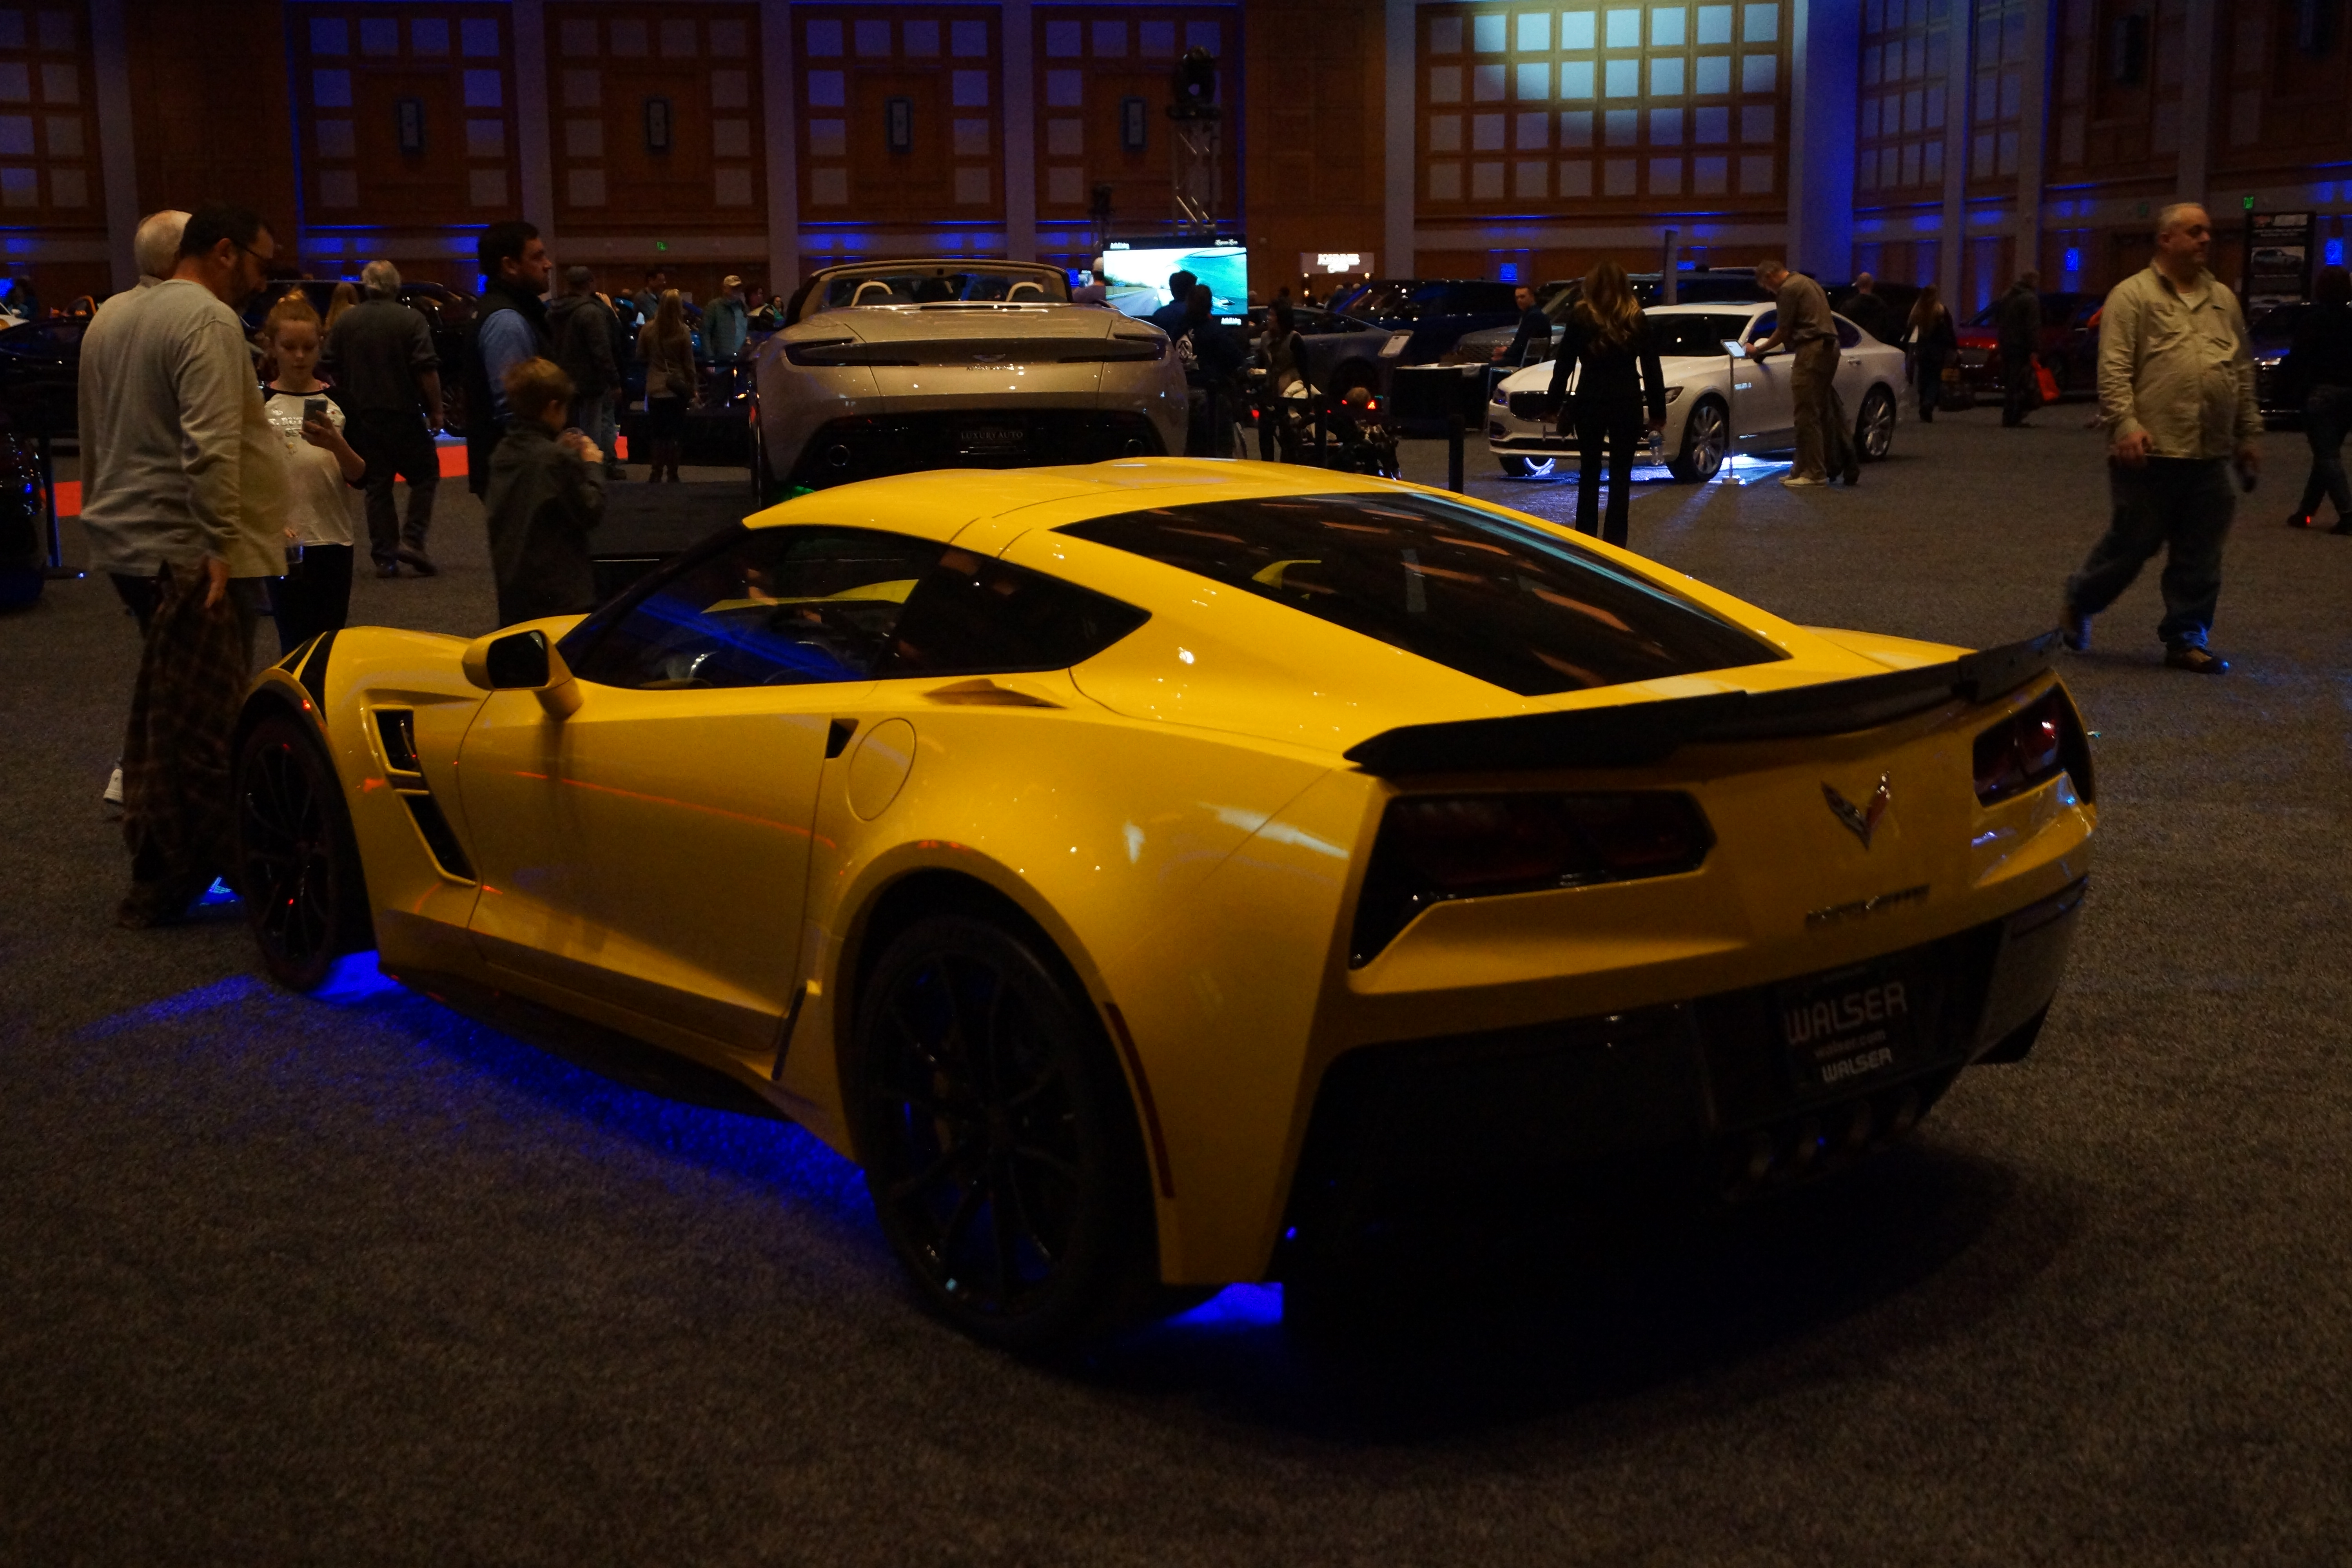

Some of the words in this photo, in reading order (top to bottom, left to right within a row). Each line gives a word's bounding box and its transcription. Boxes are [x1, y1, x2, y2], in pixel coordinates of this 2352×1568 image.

[961, 432, 996, 441] LUXURY
[1783, 981, 1908, 1047] WALSER
[1822, 1047, 1893, 1083] WALSER
